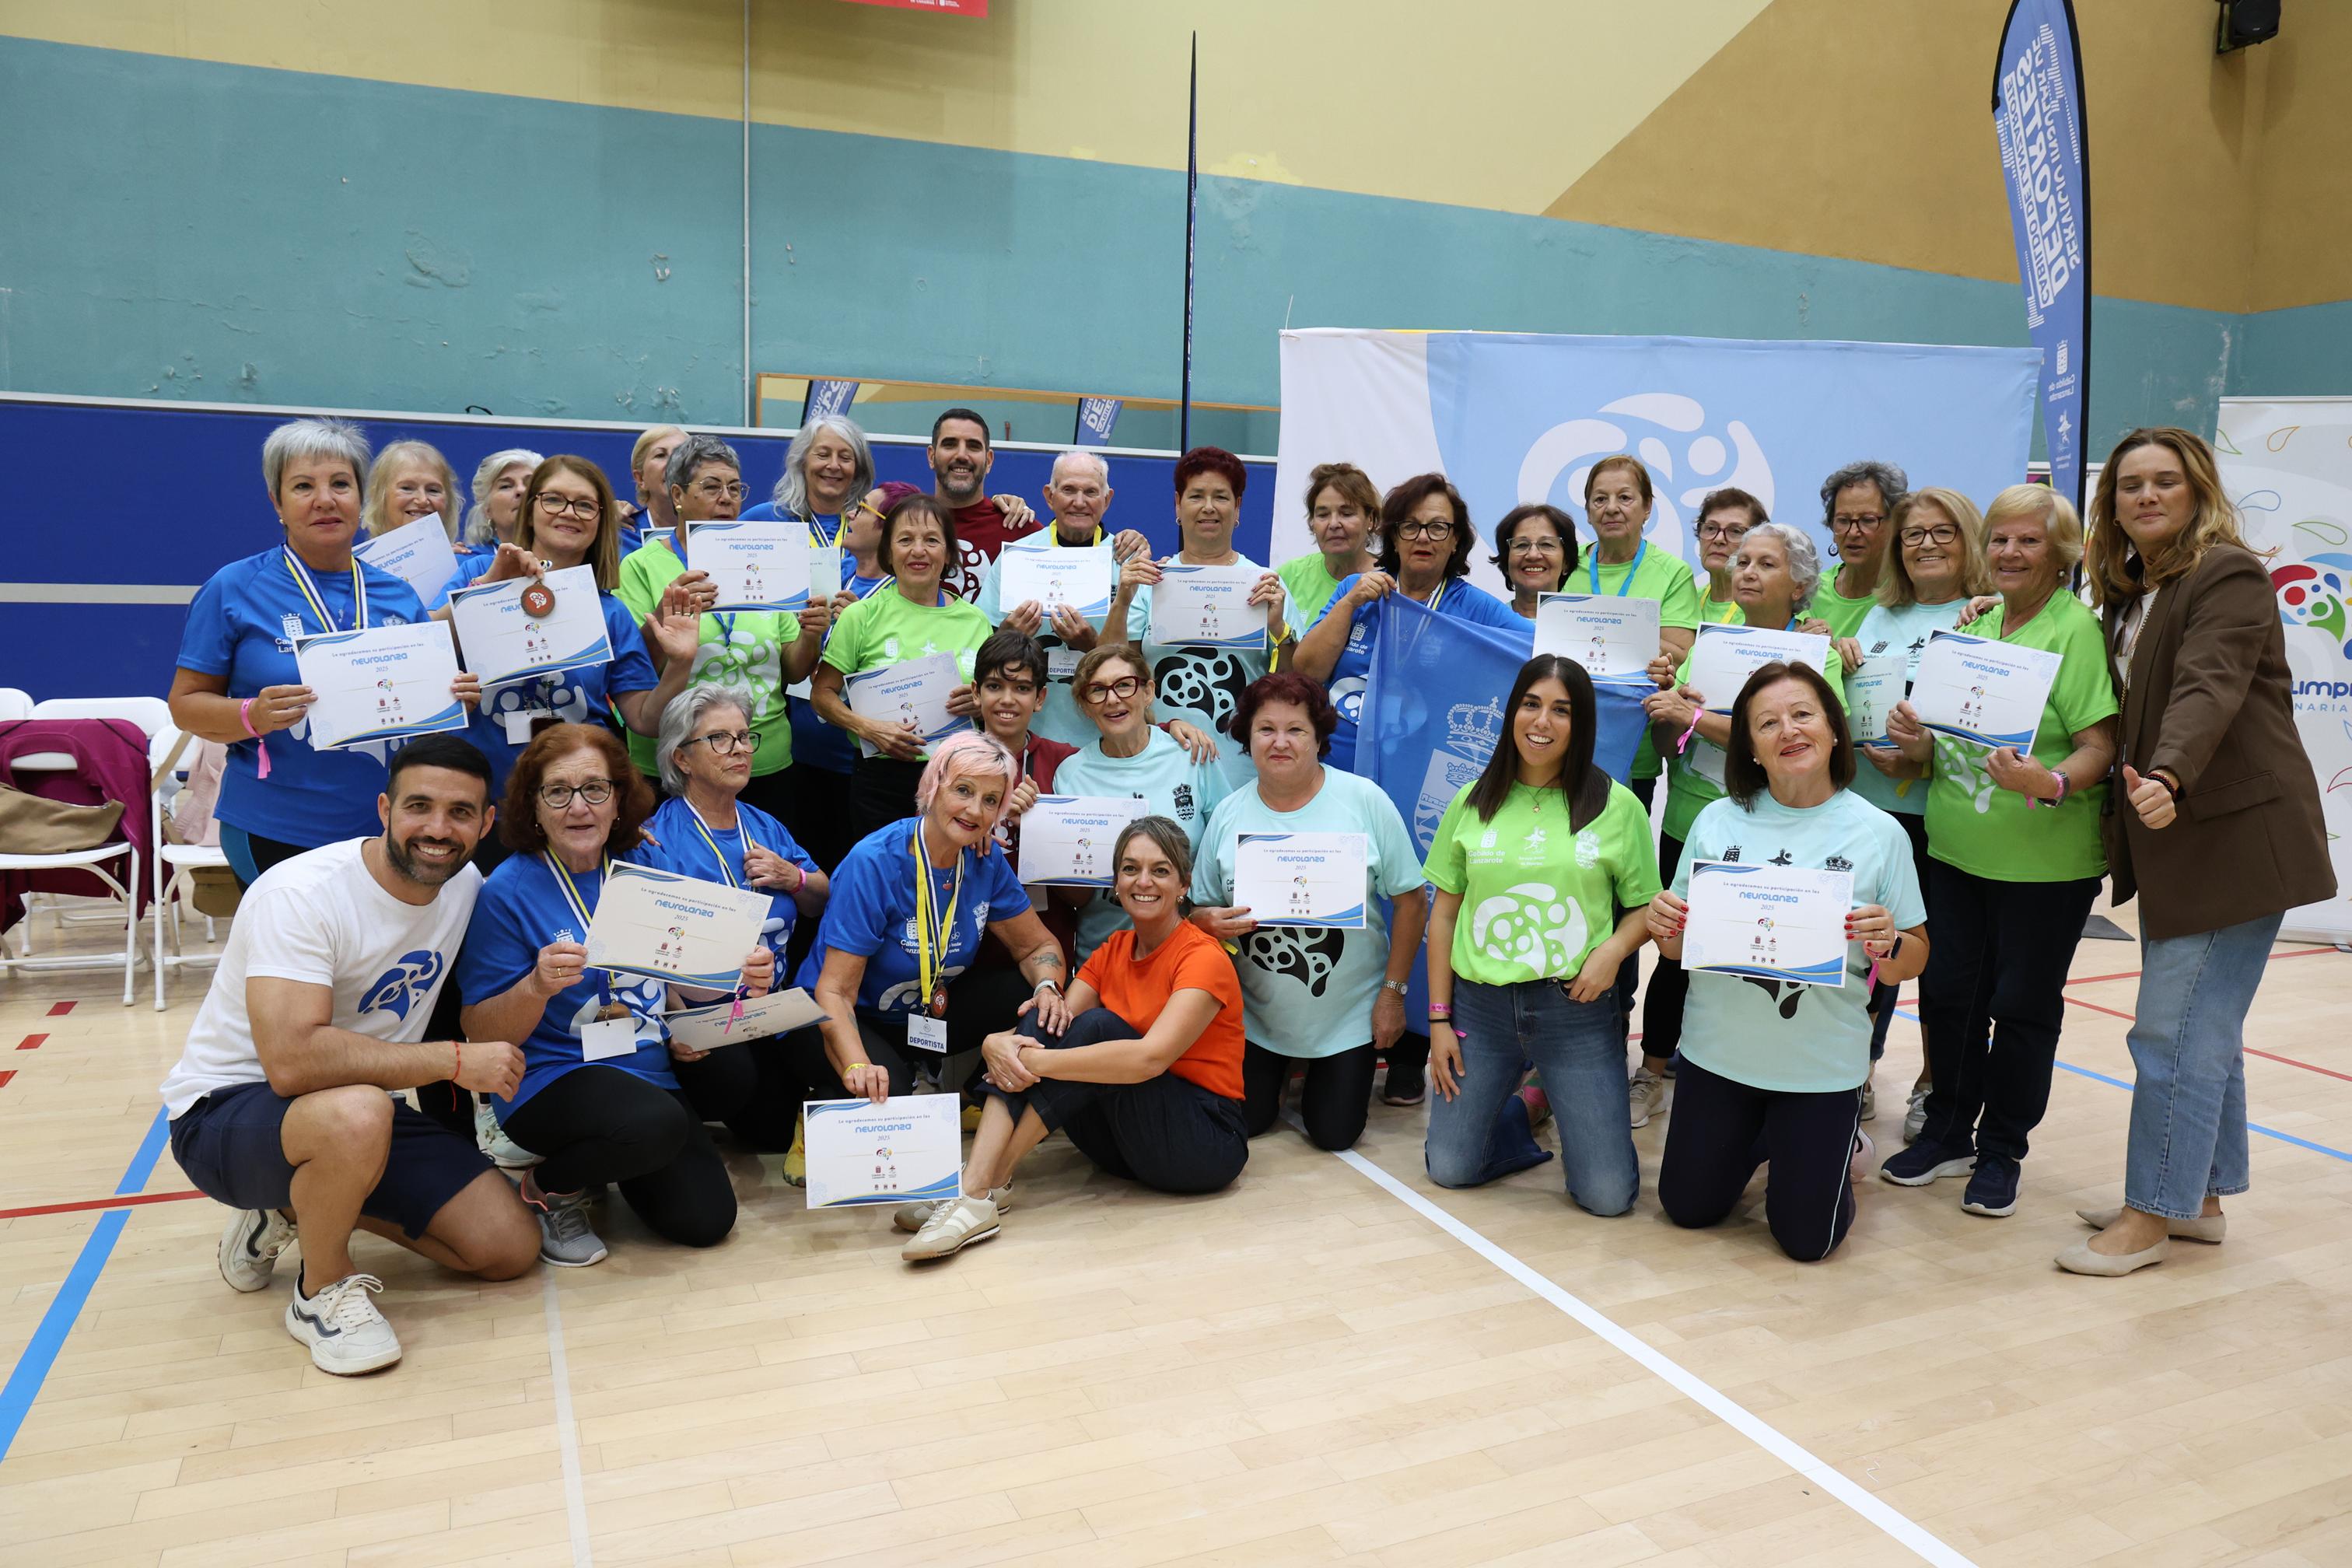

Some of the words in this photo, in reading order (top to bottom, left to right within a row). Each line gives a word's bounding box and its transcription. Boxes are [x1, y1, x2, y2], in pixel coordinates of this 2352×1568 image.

[1730, 882, 1763, 891] agradecemos
[647, 888, 681, 901] agradecemos
[909, 1036, 944, 1049] DEPORTISTA
